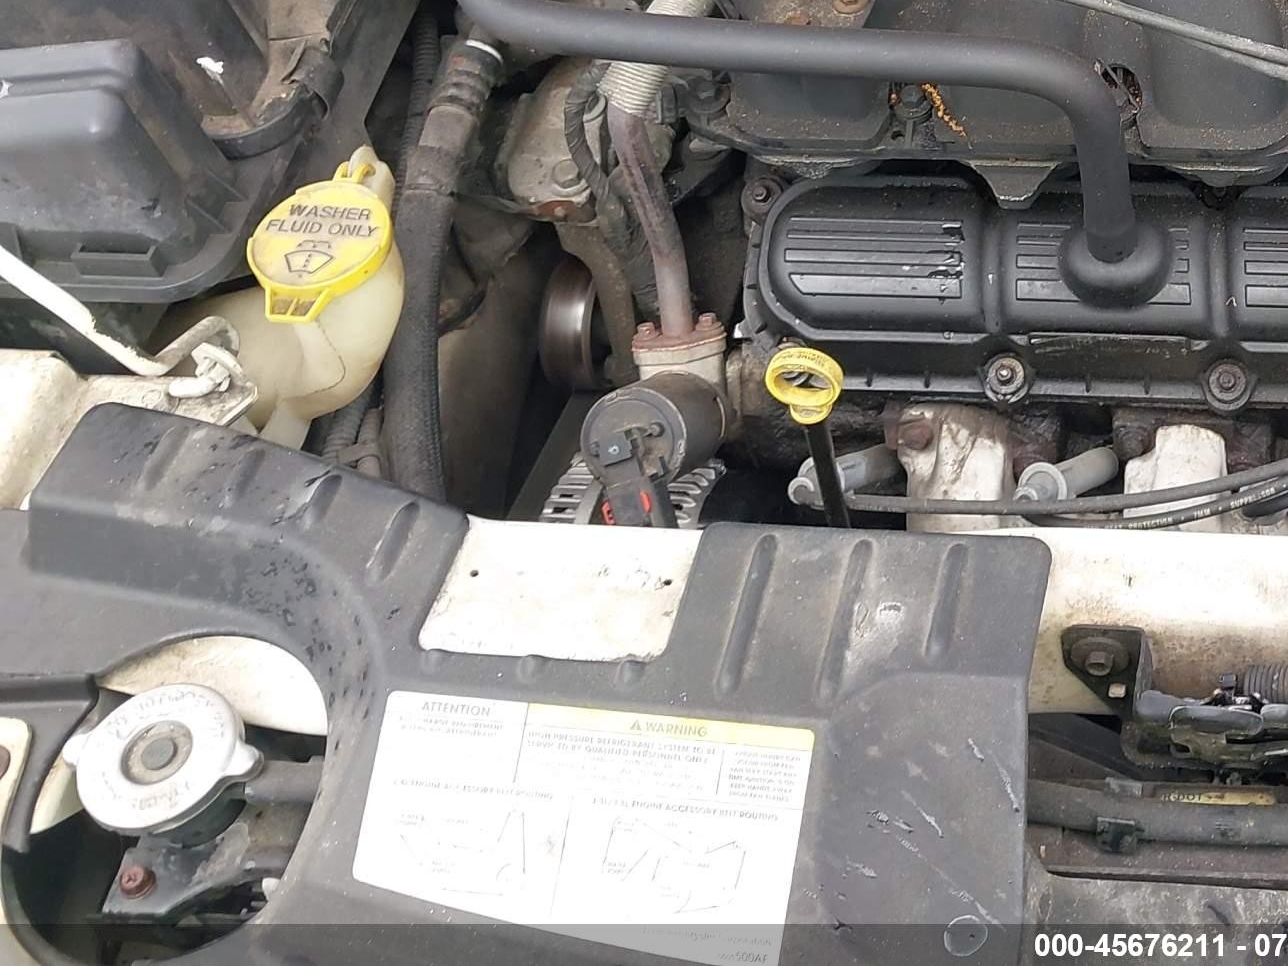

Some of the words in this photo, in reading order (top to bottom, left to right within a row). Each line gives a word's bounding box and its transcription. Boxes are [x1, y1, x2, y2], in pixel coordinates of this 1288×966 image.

[289, 203, 371, 221] WASHER
[265, 218, 322, 233] FLUID
[327, 222, 378, 238] ONLY
[1128, 516, 1174, 530] PROTECTION
[421, 700, 491, 717] ATTENTION
[645, 721, 709, 738] WARNING
